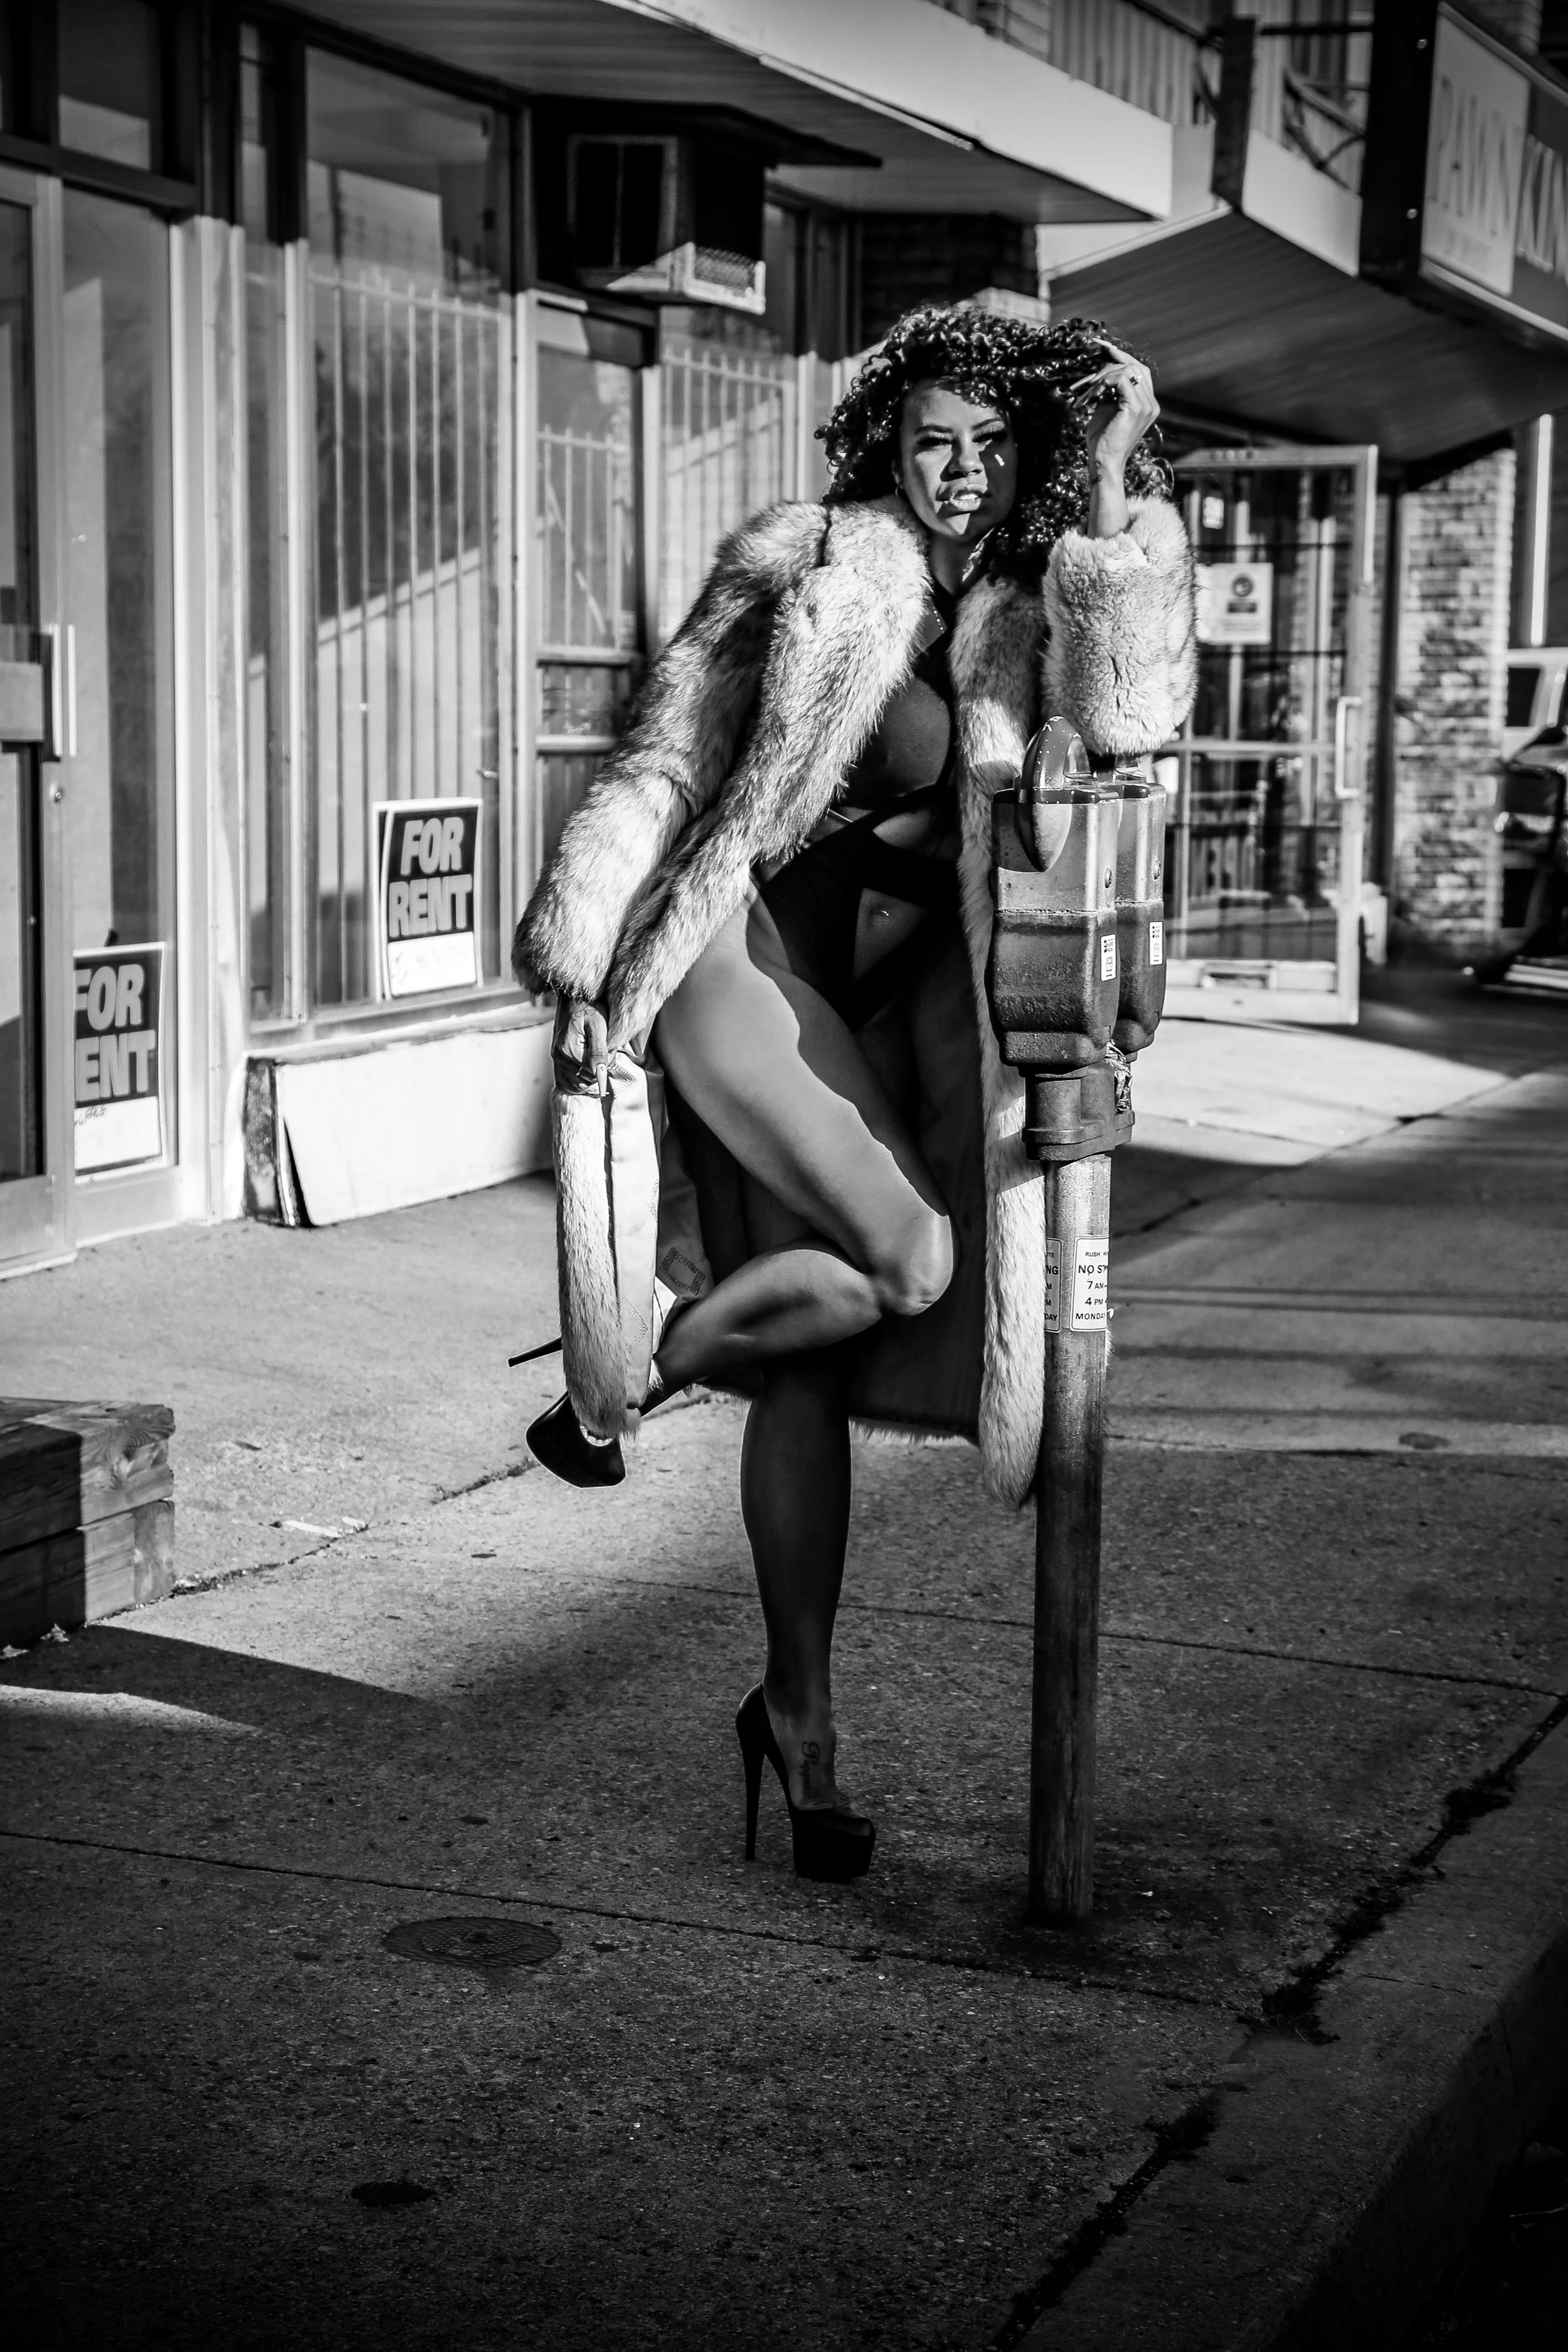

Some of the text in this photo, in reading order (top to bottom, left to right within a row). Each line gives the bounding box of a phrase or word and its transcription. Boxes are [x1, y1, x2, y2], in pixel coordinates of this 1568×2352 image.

[400, 816, 465, 877] FOR
[388, 873, 473, 939] RENT
[75, 1029, 157, 1103] ENT
[1078, 1264, 1094, 1274] NO
